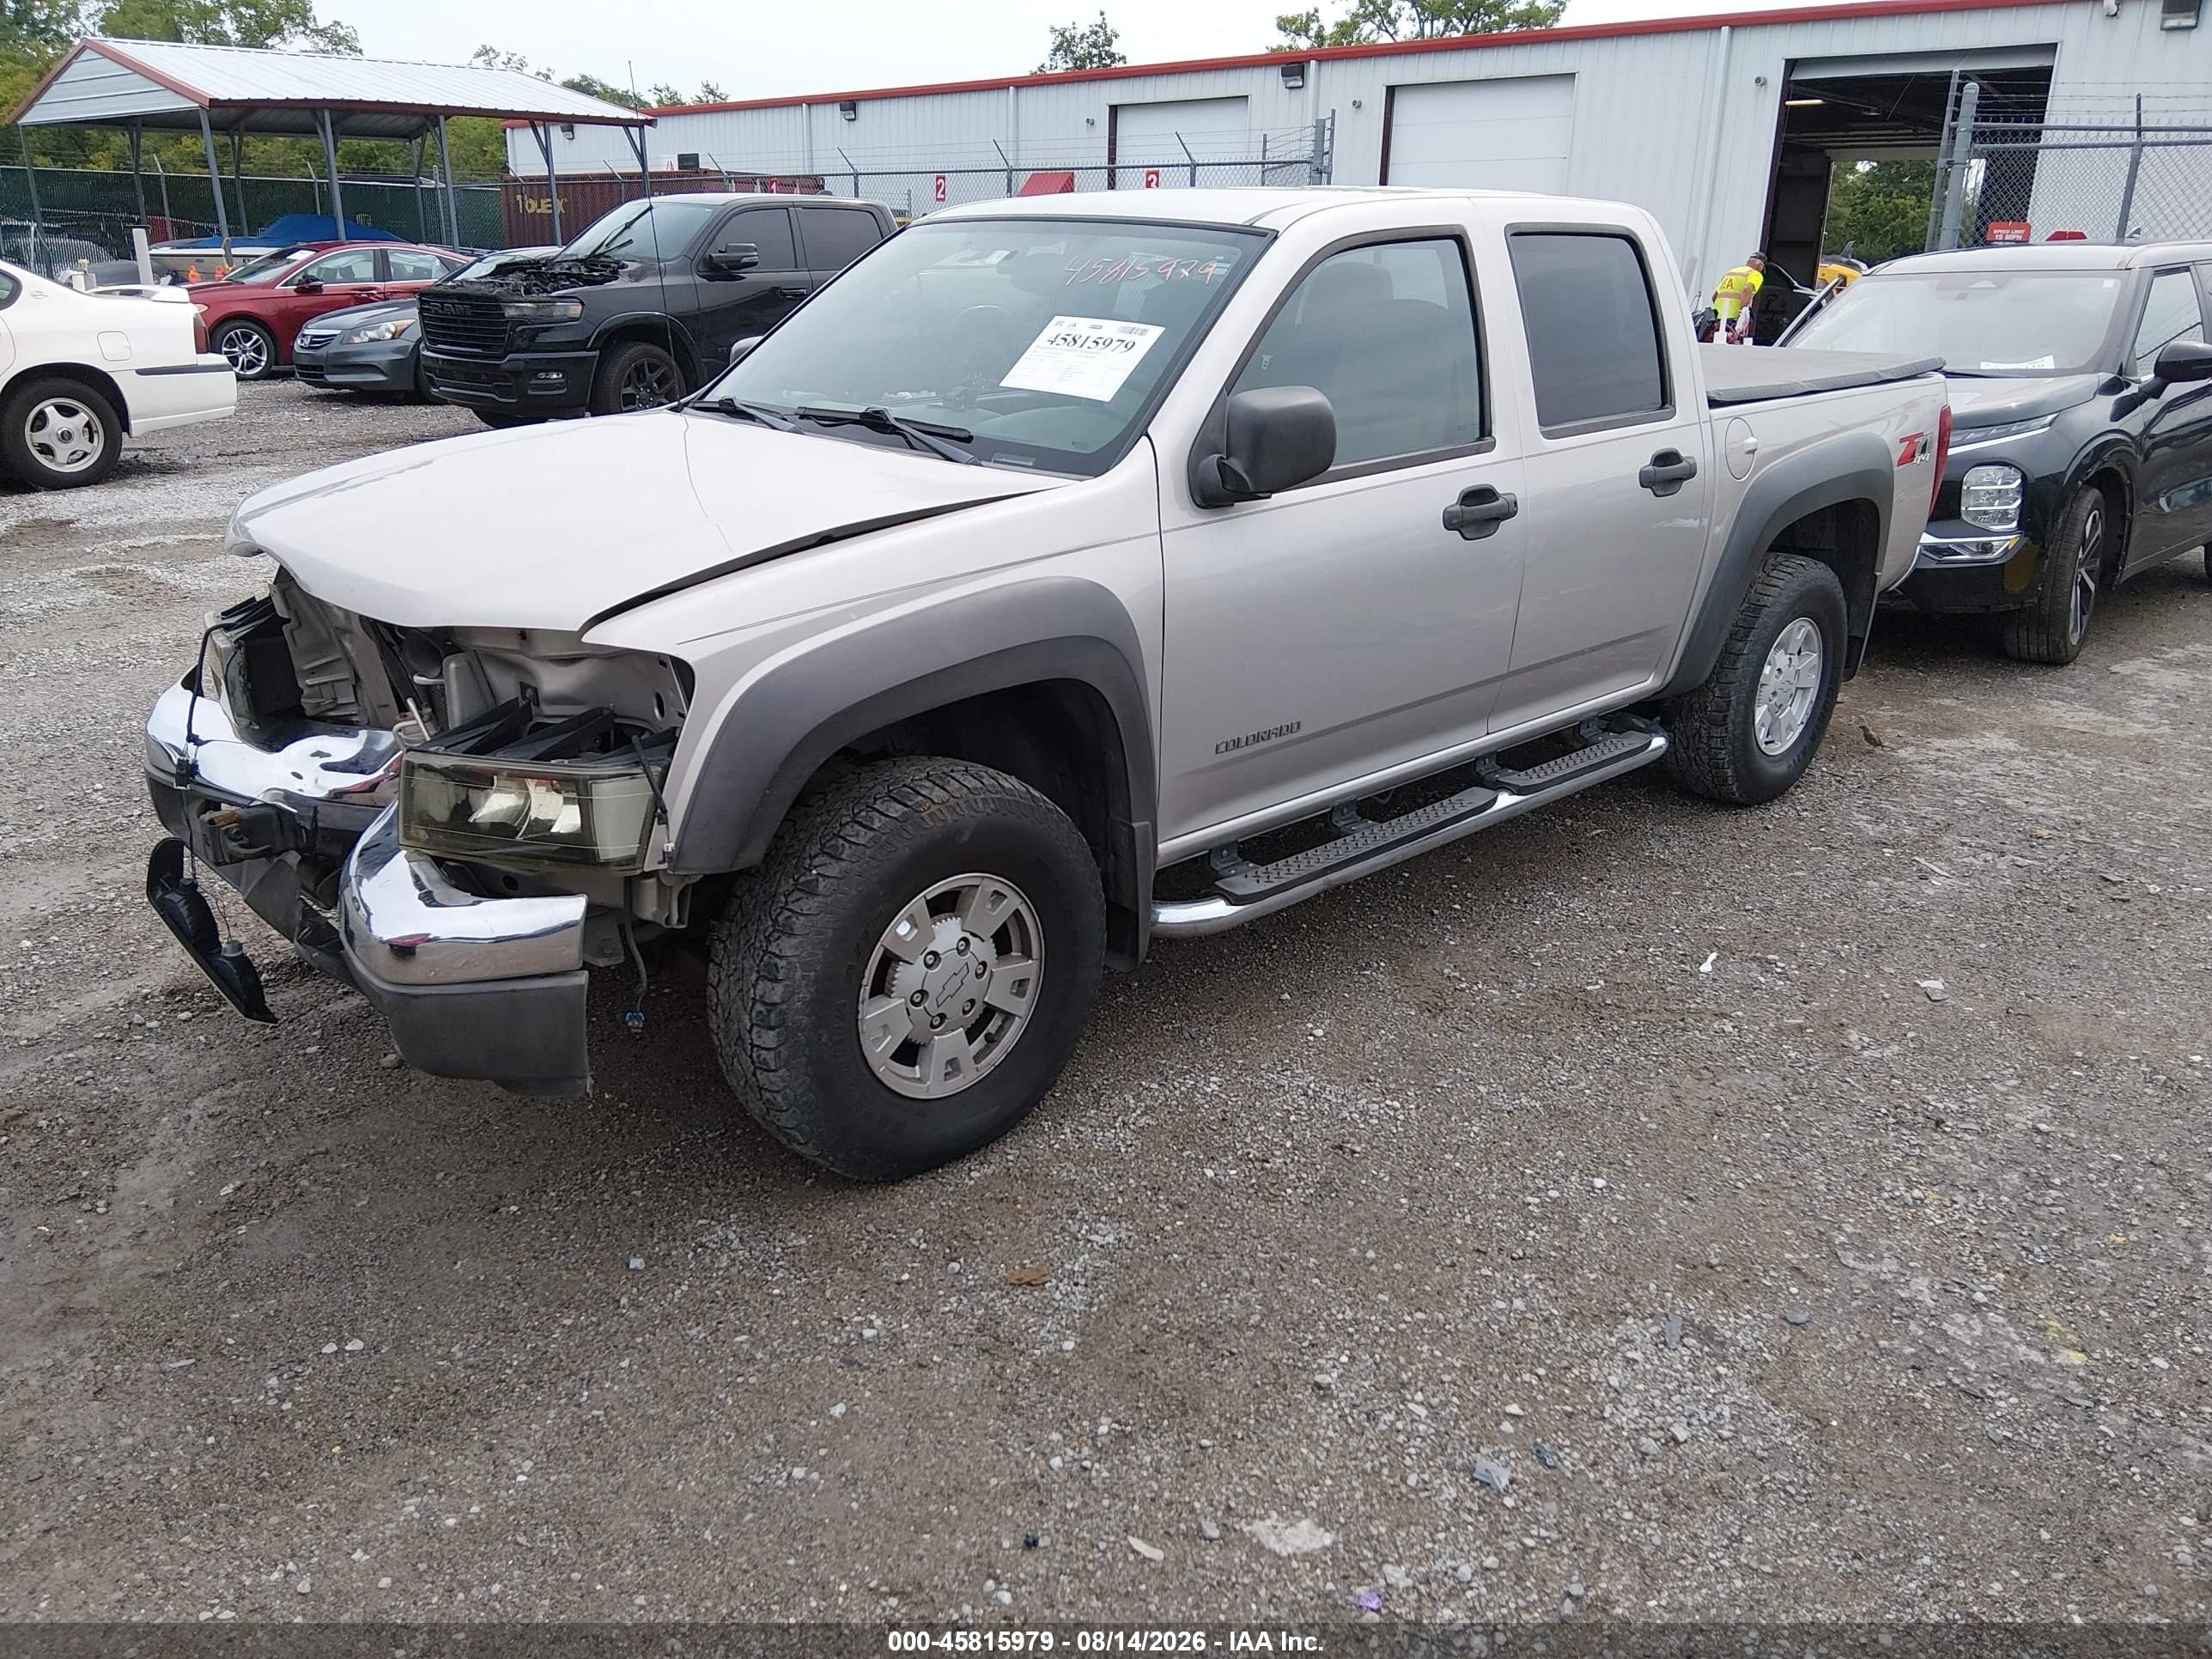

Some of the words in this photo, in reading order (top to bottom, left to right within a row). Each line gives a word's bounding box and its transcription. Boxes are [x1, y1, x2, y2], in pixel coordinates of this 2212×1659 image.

[937, 178, 945, 199] 2
[1047, 332, 1136, 354] 45815979
[1214, 720, 1302, 755] COLORADO
